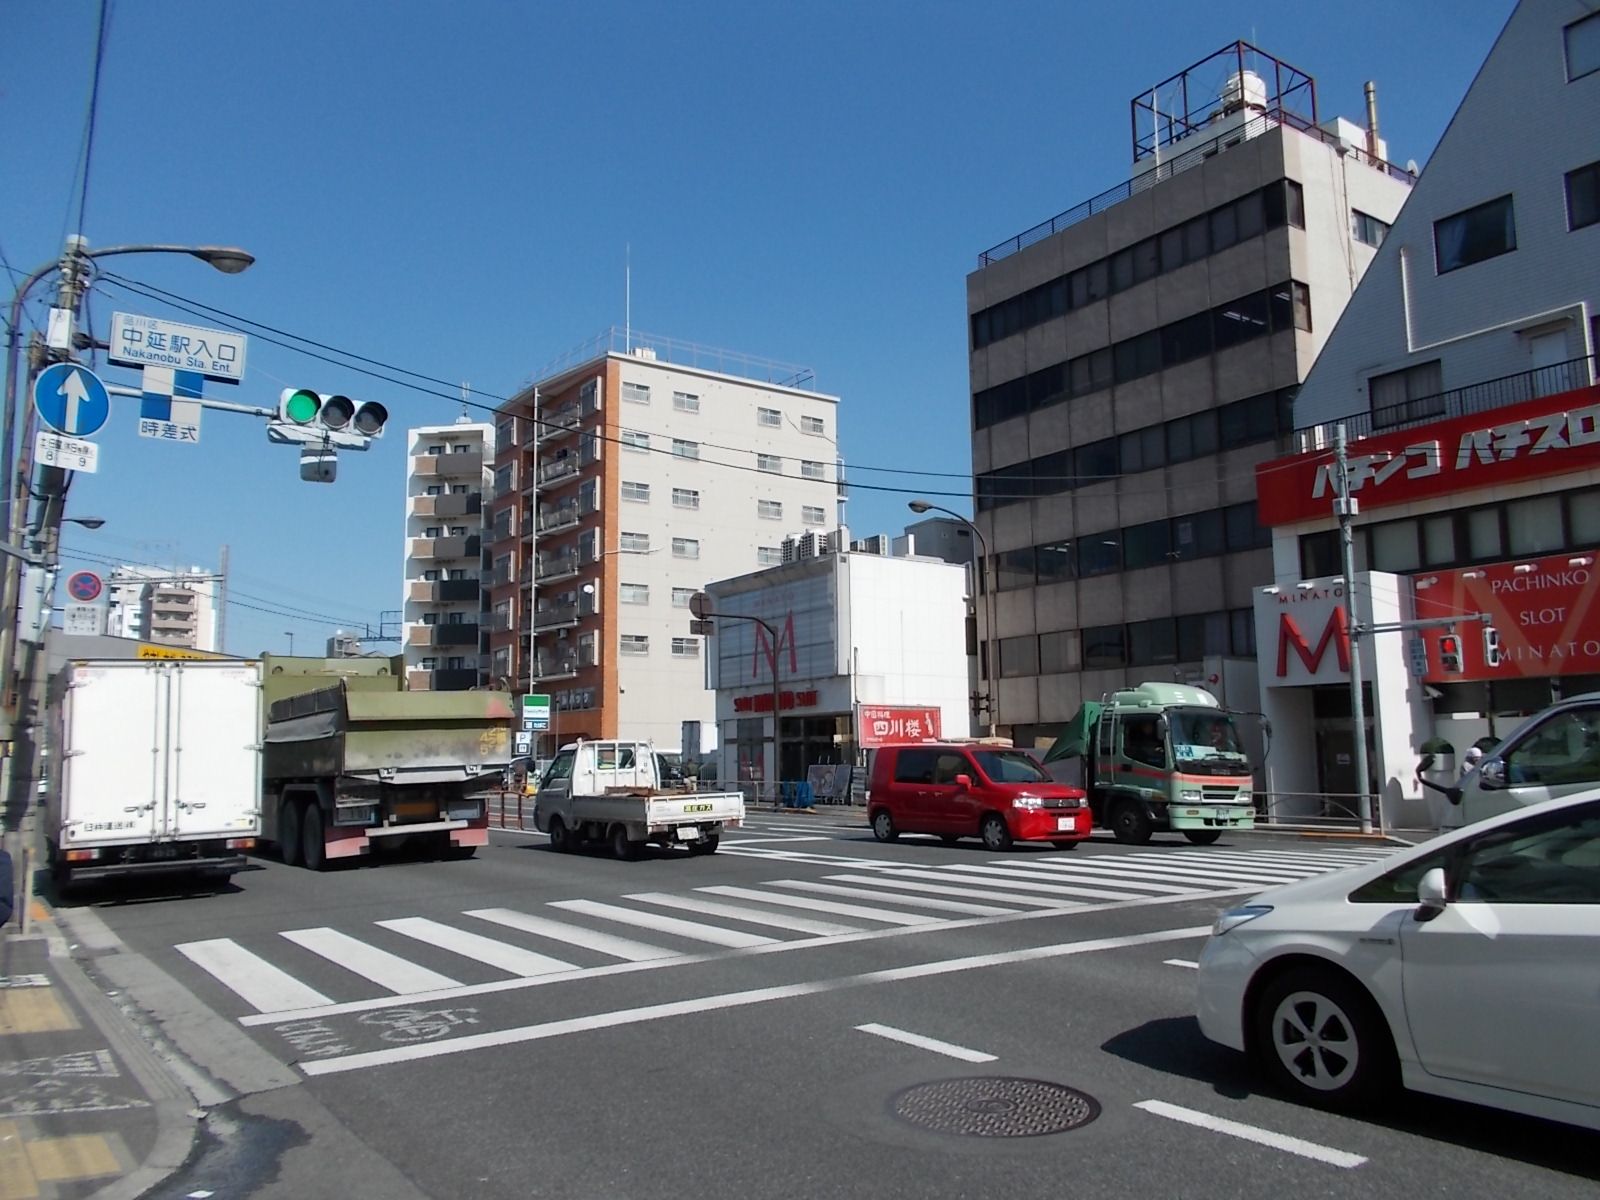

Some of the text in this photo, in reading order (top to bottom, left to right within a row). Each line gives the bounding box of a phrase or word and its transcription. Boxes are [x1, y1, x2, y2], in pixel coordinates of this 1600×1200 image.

[122, 327, 236, 362] 中延駅入口
[123, 346, 233, 373] Nakanobu Sta. Ent.
[141, 420, 198, 442] 時差式
[1312, 440, 1441, 499] パチンコ
[1491, 569, 1590, 594] PACHINKO
[1279, 588, 1343, 603] MINATO
[1520, 608, 1566, 626] SLOT
[1276, 605, 1351, 677] M
[1499, 640, 1600, 661] MINATO
[873, 718, 922, 737] 四川楼
